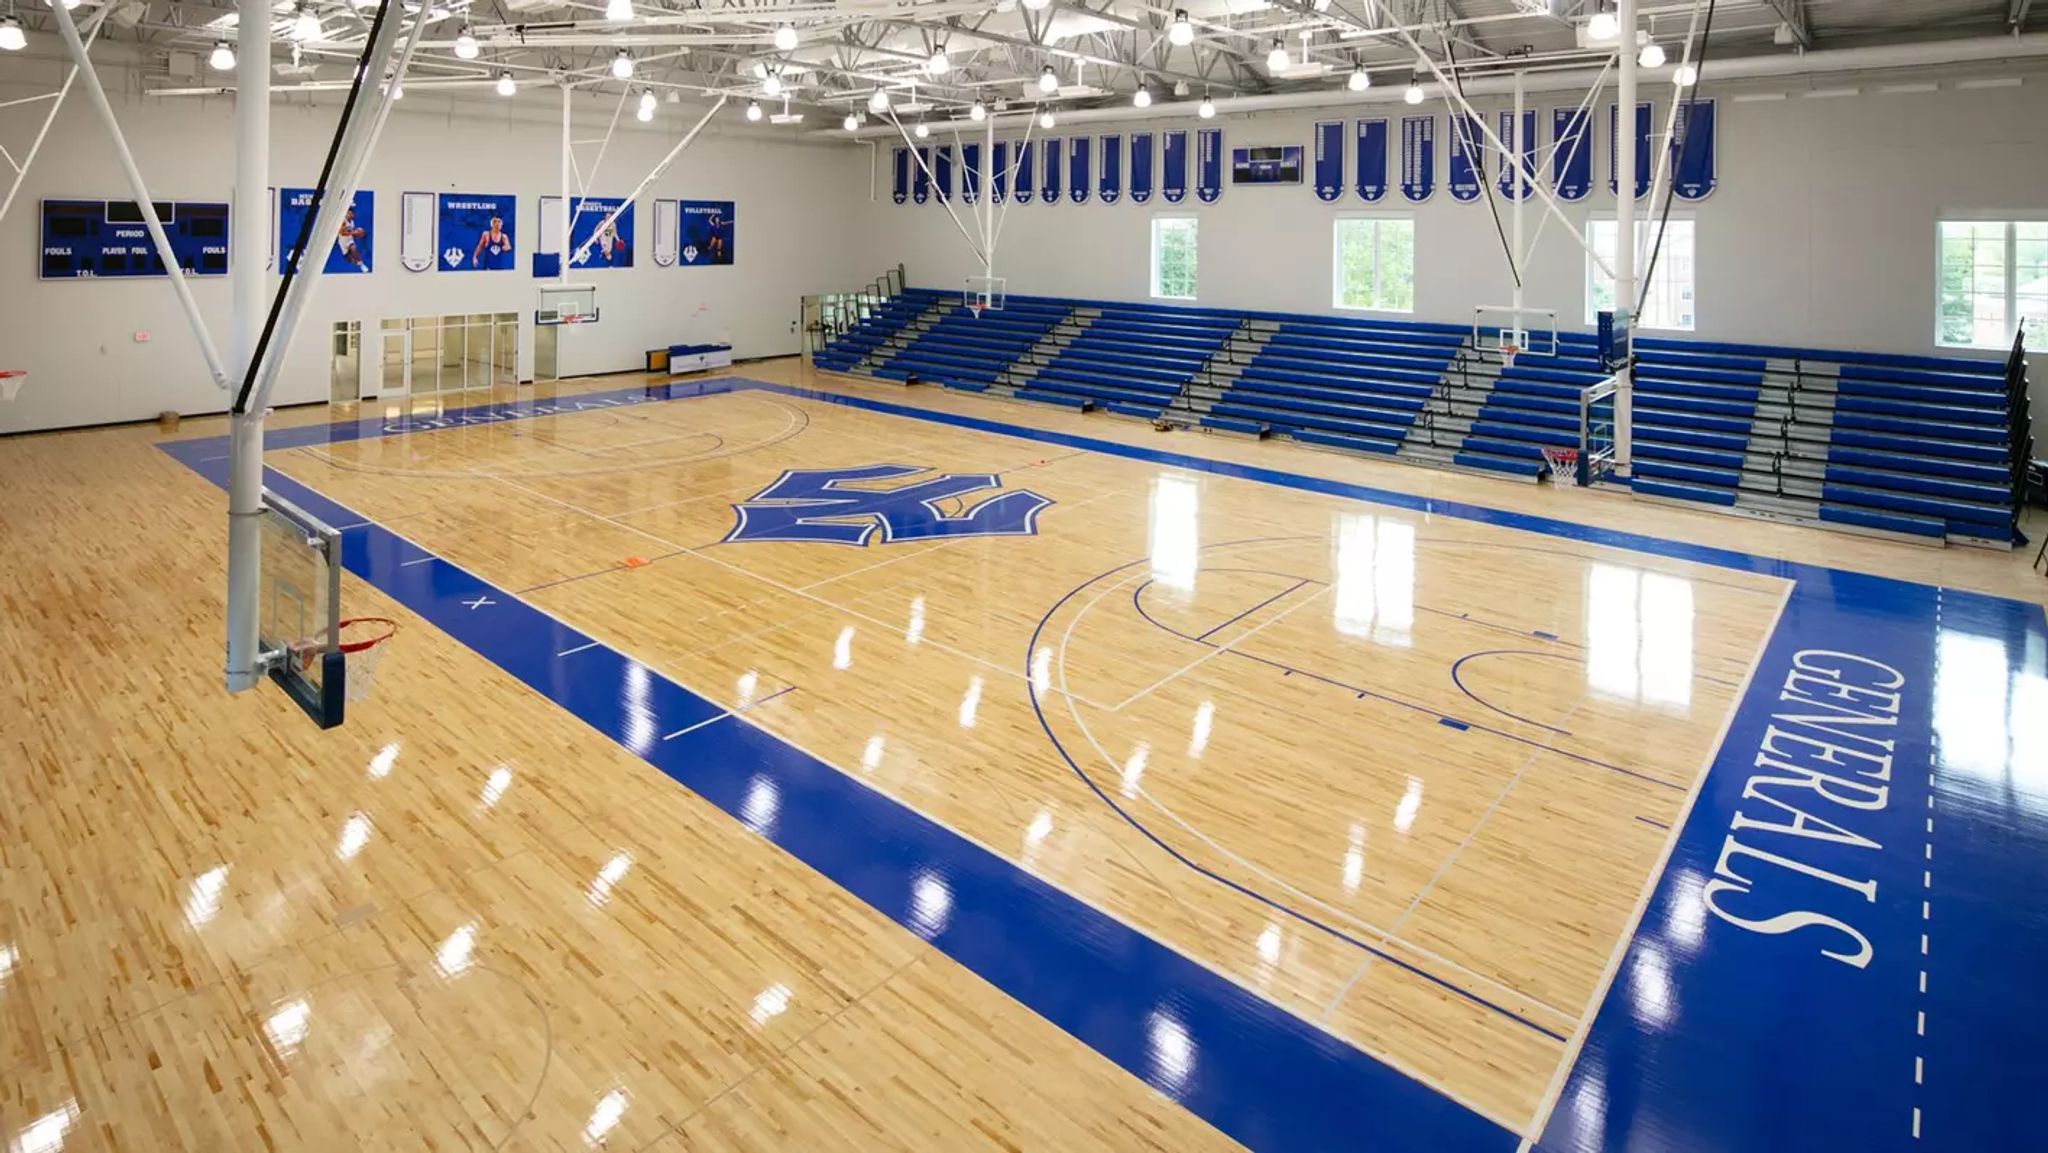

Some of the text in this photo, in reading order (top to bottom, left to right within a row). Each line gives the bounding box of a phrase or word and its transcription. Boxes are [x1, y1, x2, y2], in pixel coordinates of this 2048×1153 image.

[447, 201, 497, 210] WRESTLING
[115, 230, 145, 238] PERIOD
[45, 247, 72, 256] FOULS
[102, 247, 148, 255] PLAYER FOUL
[202, 246, 226, 255] FOULS
[384, 394, 659, 433] GENERALS
[1703, 649, 1905, 969] GENERALS
